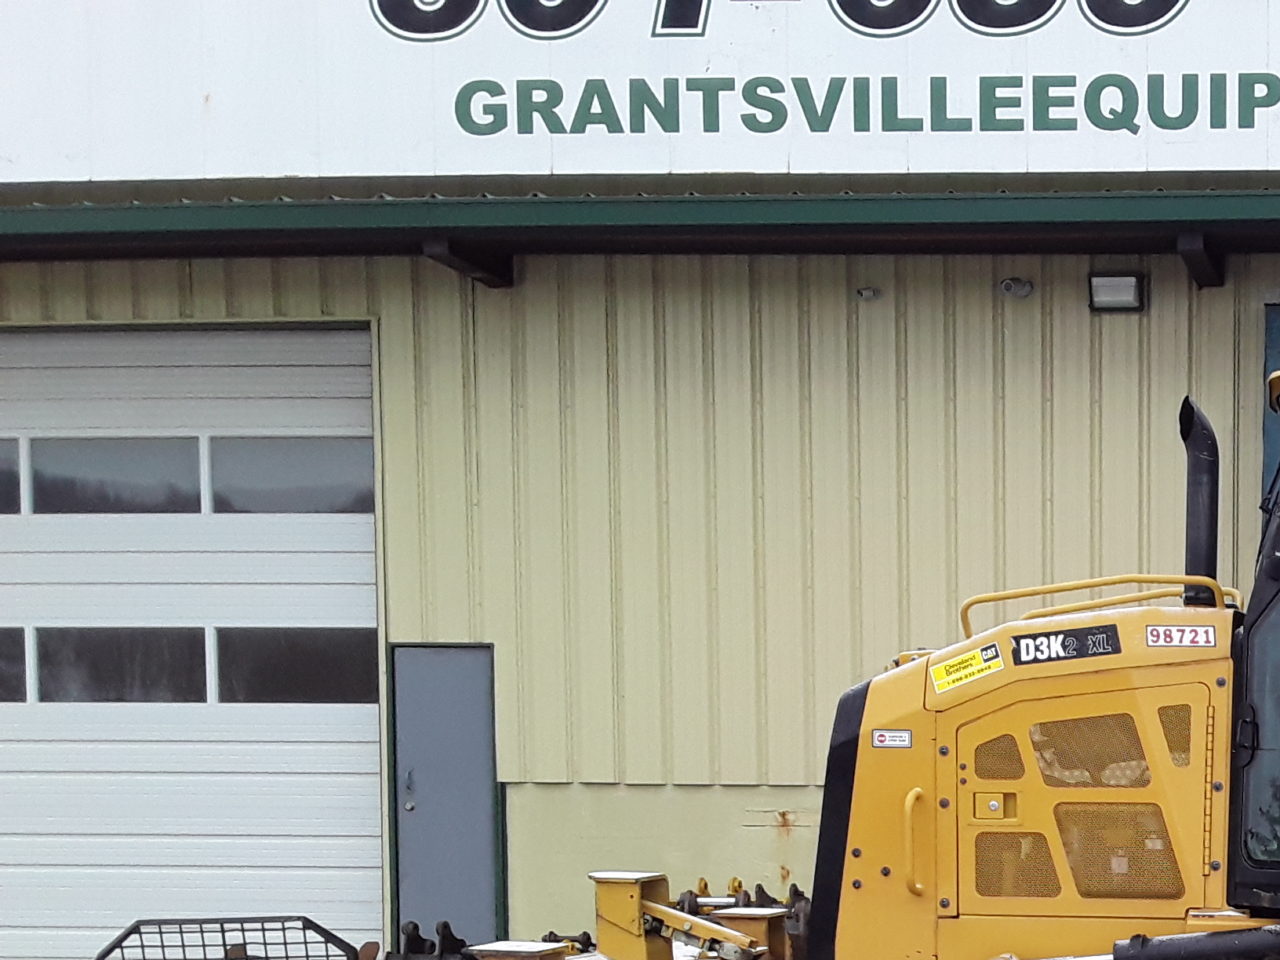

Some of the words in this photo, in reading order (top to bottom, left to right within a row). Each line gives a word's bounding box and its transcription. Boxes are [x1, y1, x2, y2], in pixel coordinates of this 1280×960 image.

[1150, 628, 1212, 644] 98721
[1088, 634, 1112, 654] XL
[982, 647, 996, 660] CAT
[945, 663, 974, 677] Brothers
